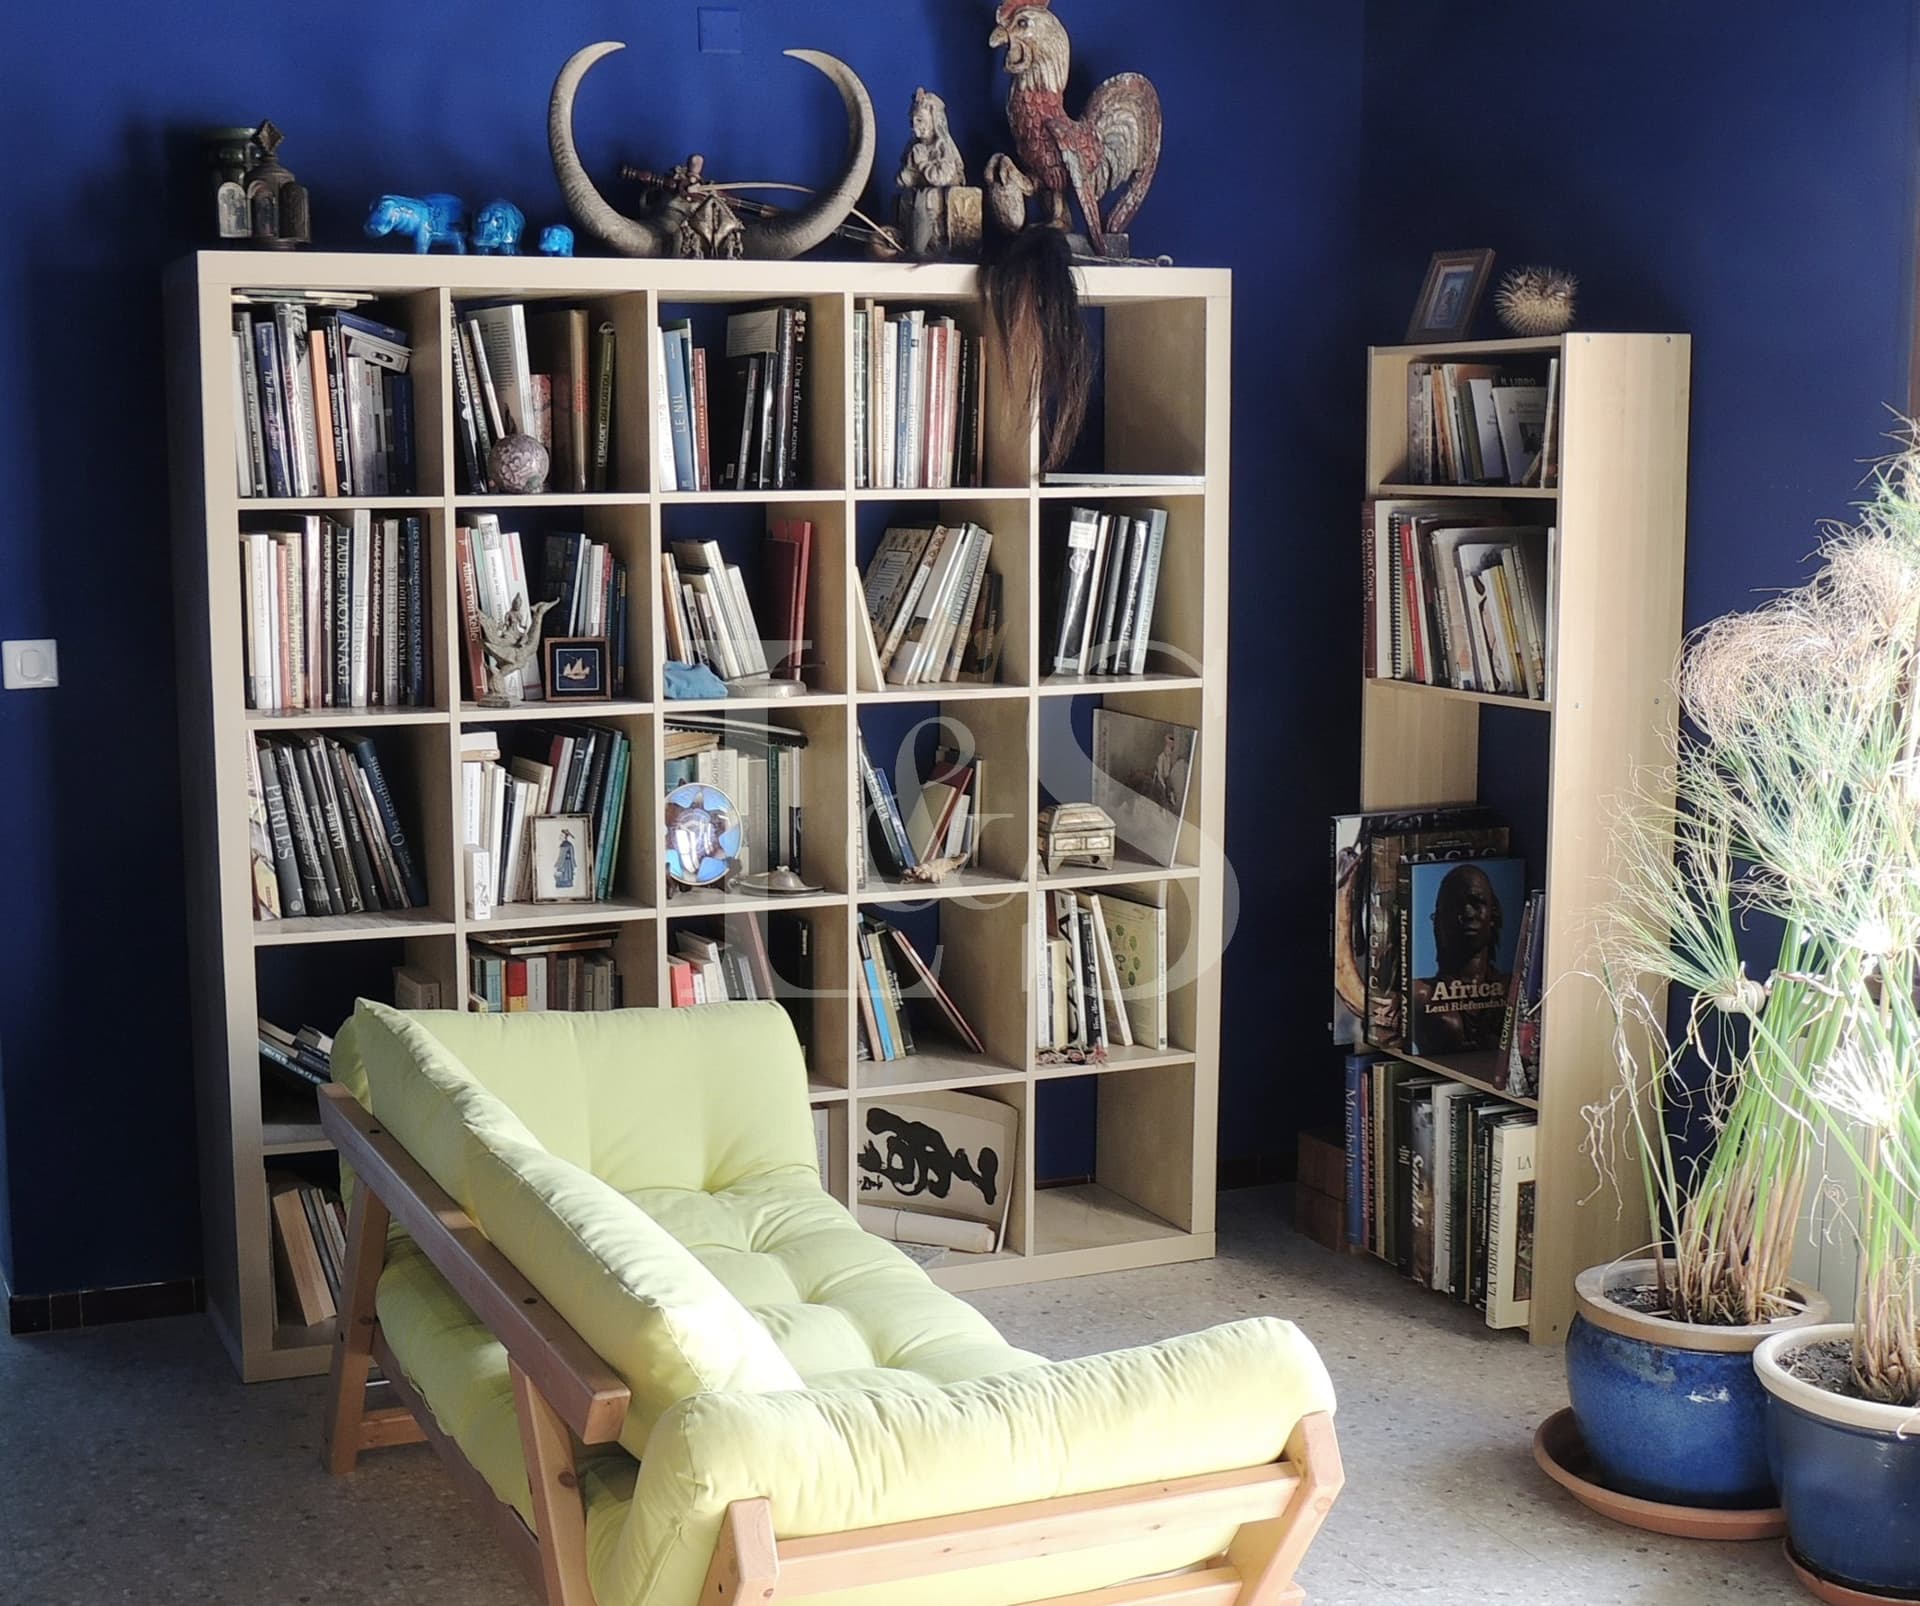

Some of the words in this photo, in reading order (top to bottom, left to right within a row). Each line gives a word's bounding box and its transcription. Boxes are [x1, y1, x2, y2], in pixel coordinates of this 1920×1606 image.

[671, 392, 684, 413] NIL
[675, 419, 687, 433] LE
[337, 534, 348, 578] L'AUBE
[1366, 528, 1375, 566] GRAND
[462, 562, 474, 592] Albert
[1367, 568, 1376, 603] COURS
[398, 578, 408, 626] GOTHIQUE
[466, 594, 476, 613] von
[337, 594, 349, 650] MOYEN
[467, 616, 480, 642] Keller
[398, 631, 408, 666] FRANCE
[338, 654, 349, 684] AGE
[266, 784, 294, 860] PERLES
[324, 802, 344, 849] LALIBELA
[1400, 908, 1408, 992] Riefenstahl
[1425, 1003, 1449, 1014] Leni
[1451, 999, 1509, 1011] Riefenstah
[1431, 979, 1504, 1002] Africa
[1345, 1088, 1357, 1168] Muscheln
[1518, 1156, 1532, 1170] LA
[1410, 1151, 1425, 1228] Saudek
[1488, 1240, 1499, 1276] BIBLE
[1488, 1281, 1498, 1297] LA
